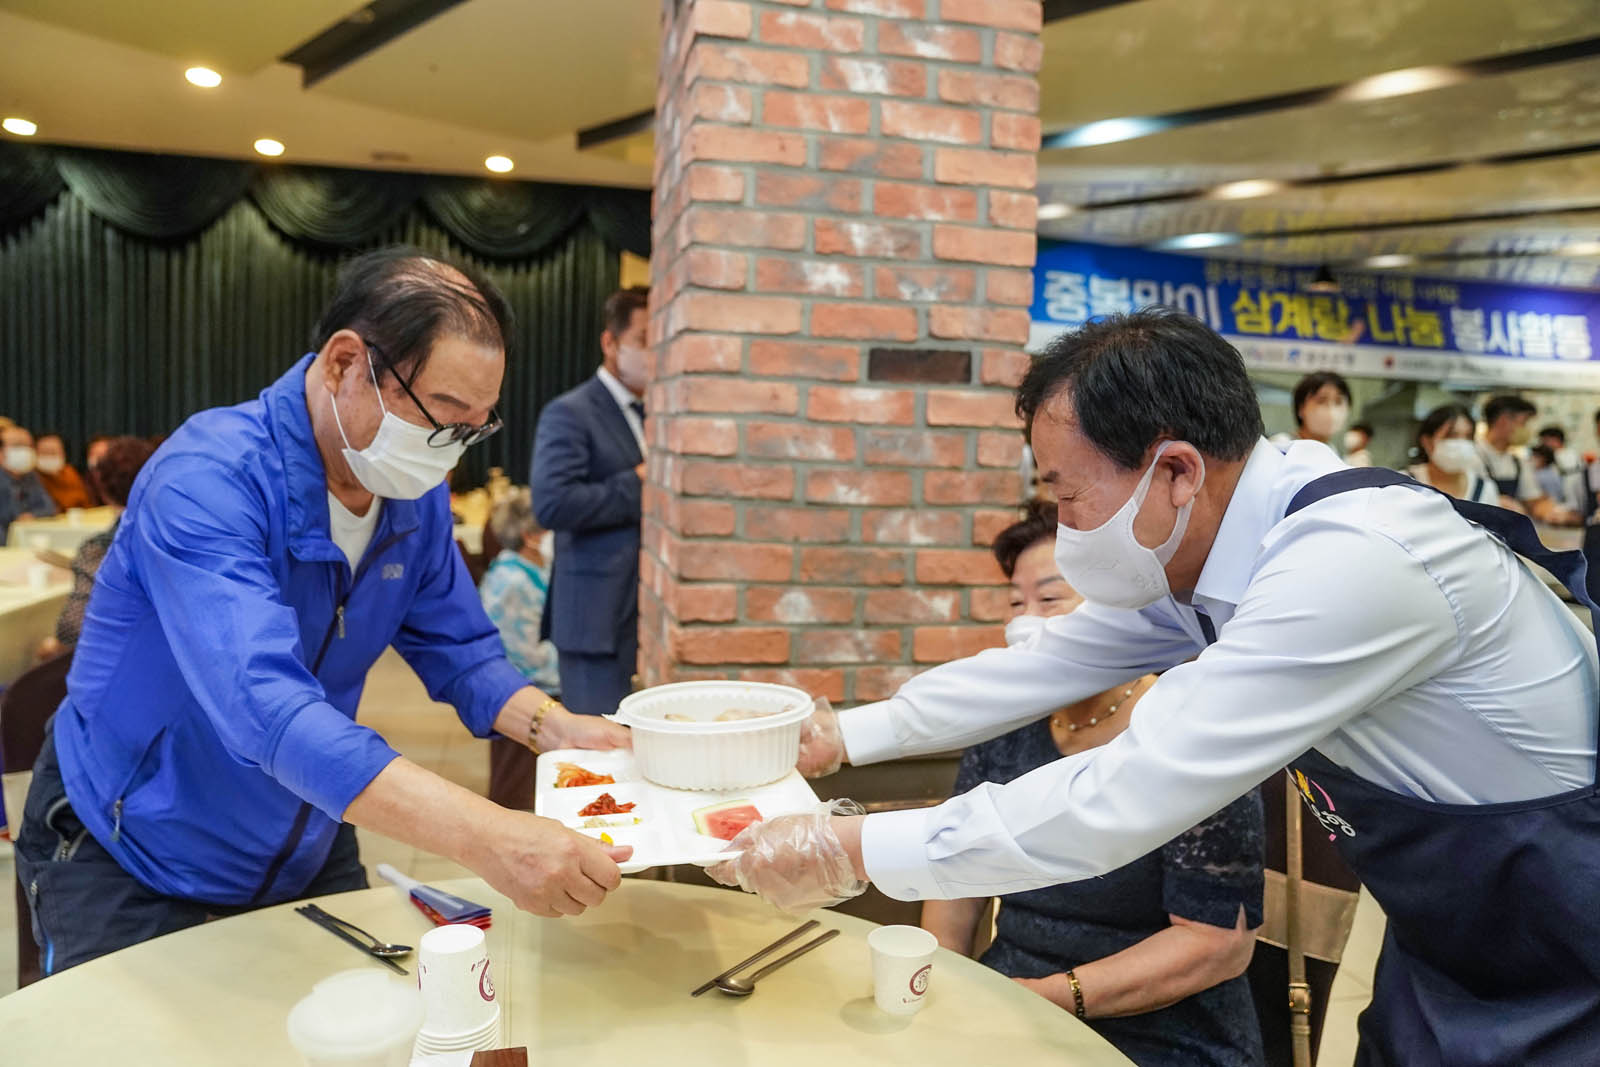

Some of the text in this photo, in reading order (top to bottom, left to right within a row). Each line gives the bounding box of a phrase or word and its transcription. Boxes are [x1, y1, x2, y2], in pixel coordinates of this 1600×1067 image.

[1231, 288, 1351, 343] 삼계탕
[1367, 301, 1445, 349] 나눔
[1450, 306, 1592, 361] 봉사활동
